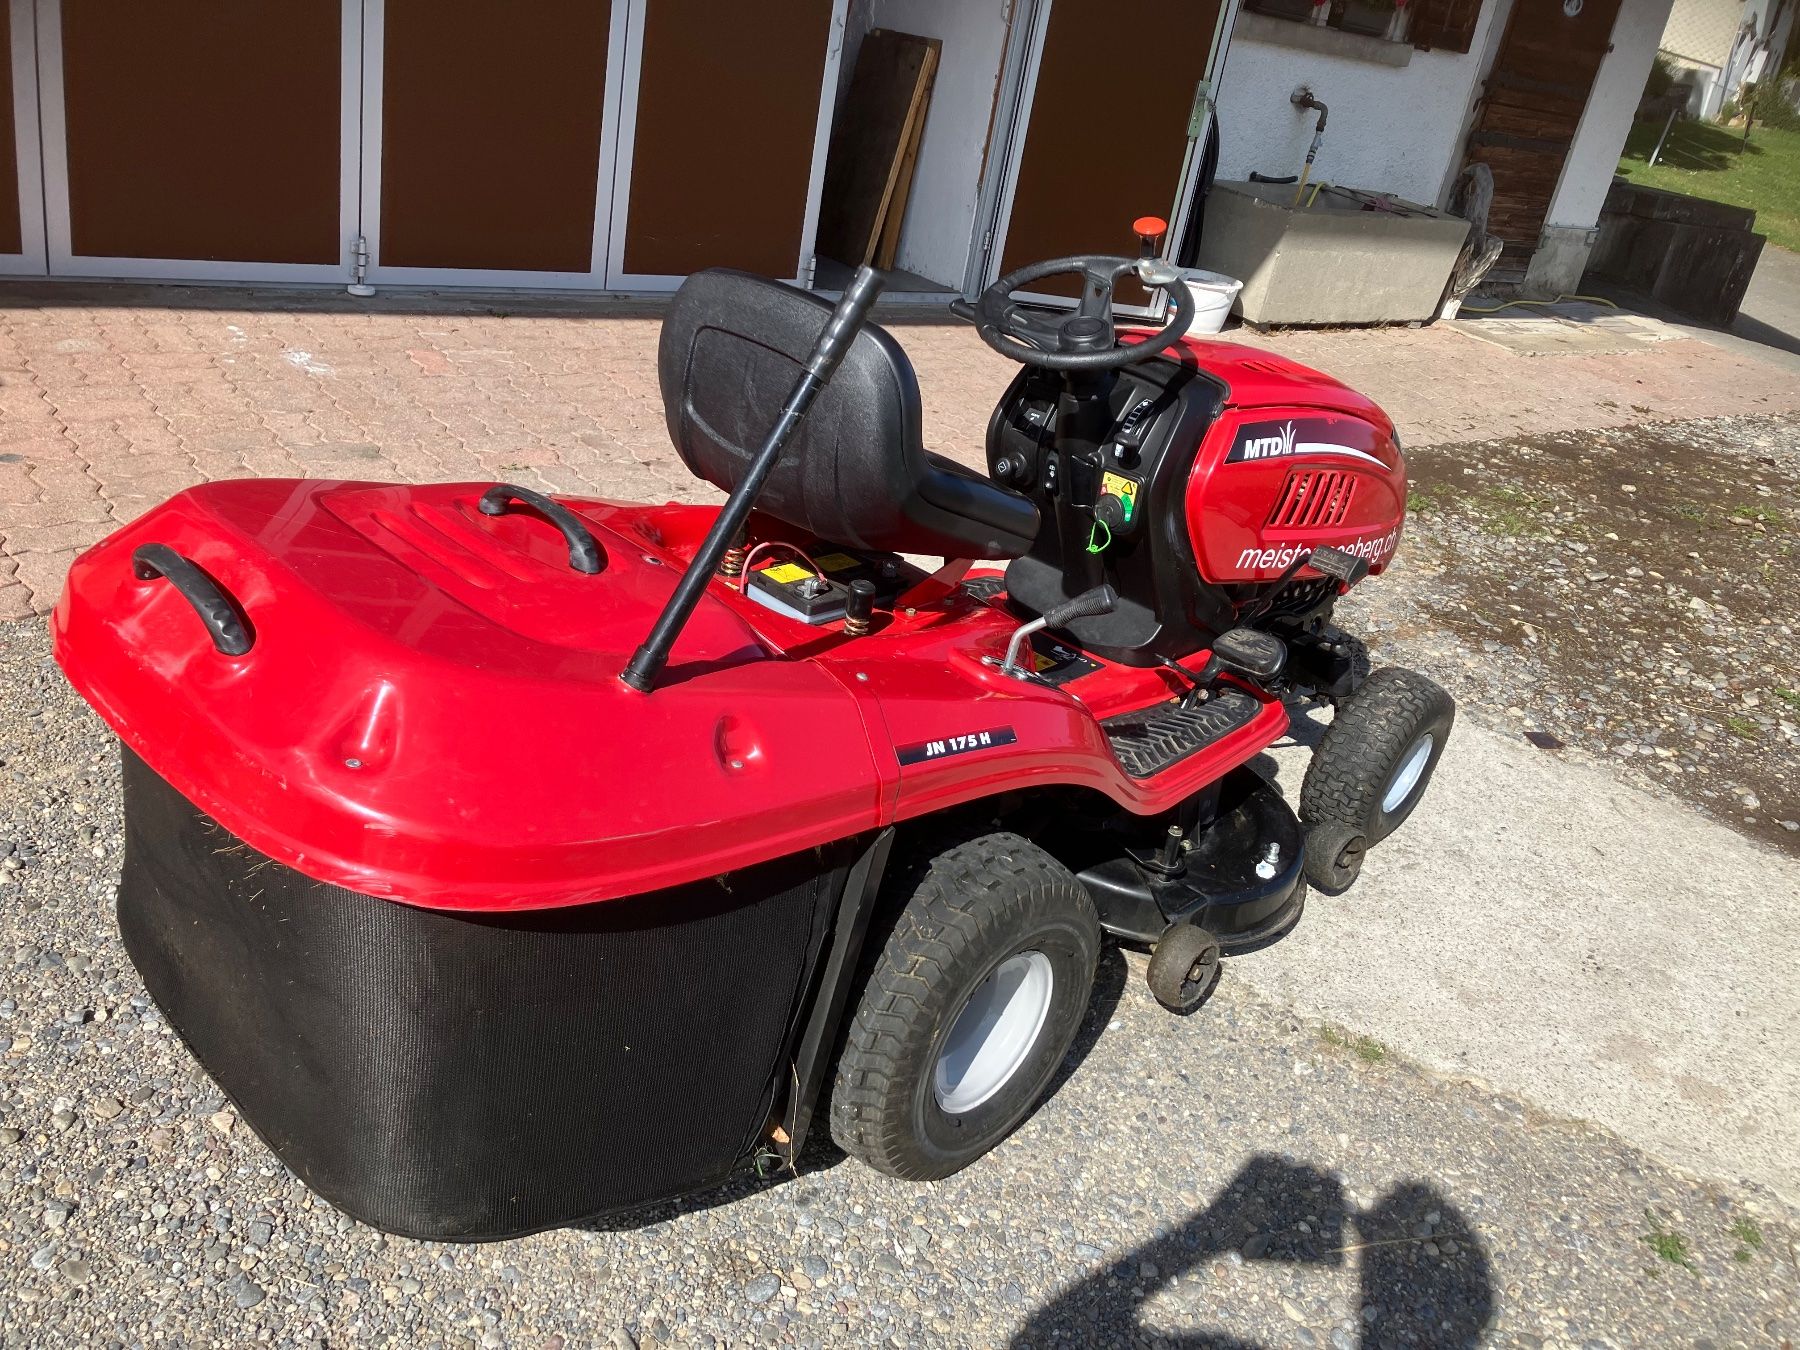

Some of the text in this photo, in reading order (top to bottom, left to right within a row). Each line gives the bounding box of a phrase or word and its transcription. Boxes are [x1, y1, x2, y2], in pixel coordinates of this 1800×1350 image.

[1243, 436, 1283, 460] MTD
[926, 731, 992, 756] JN 175 H
